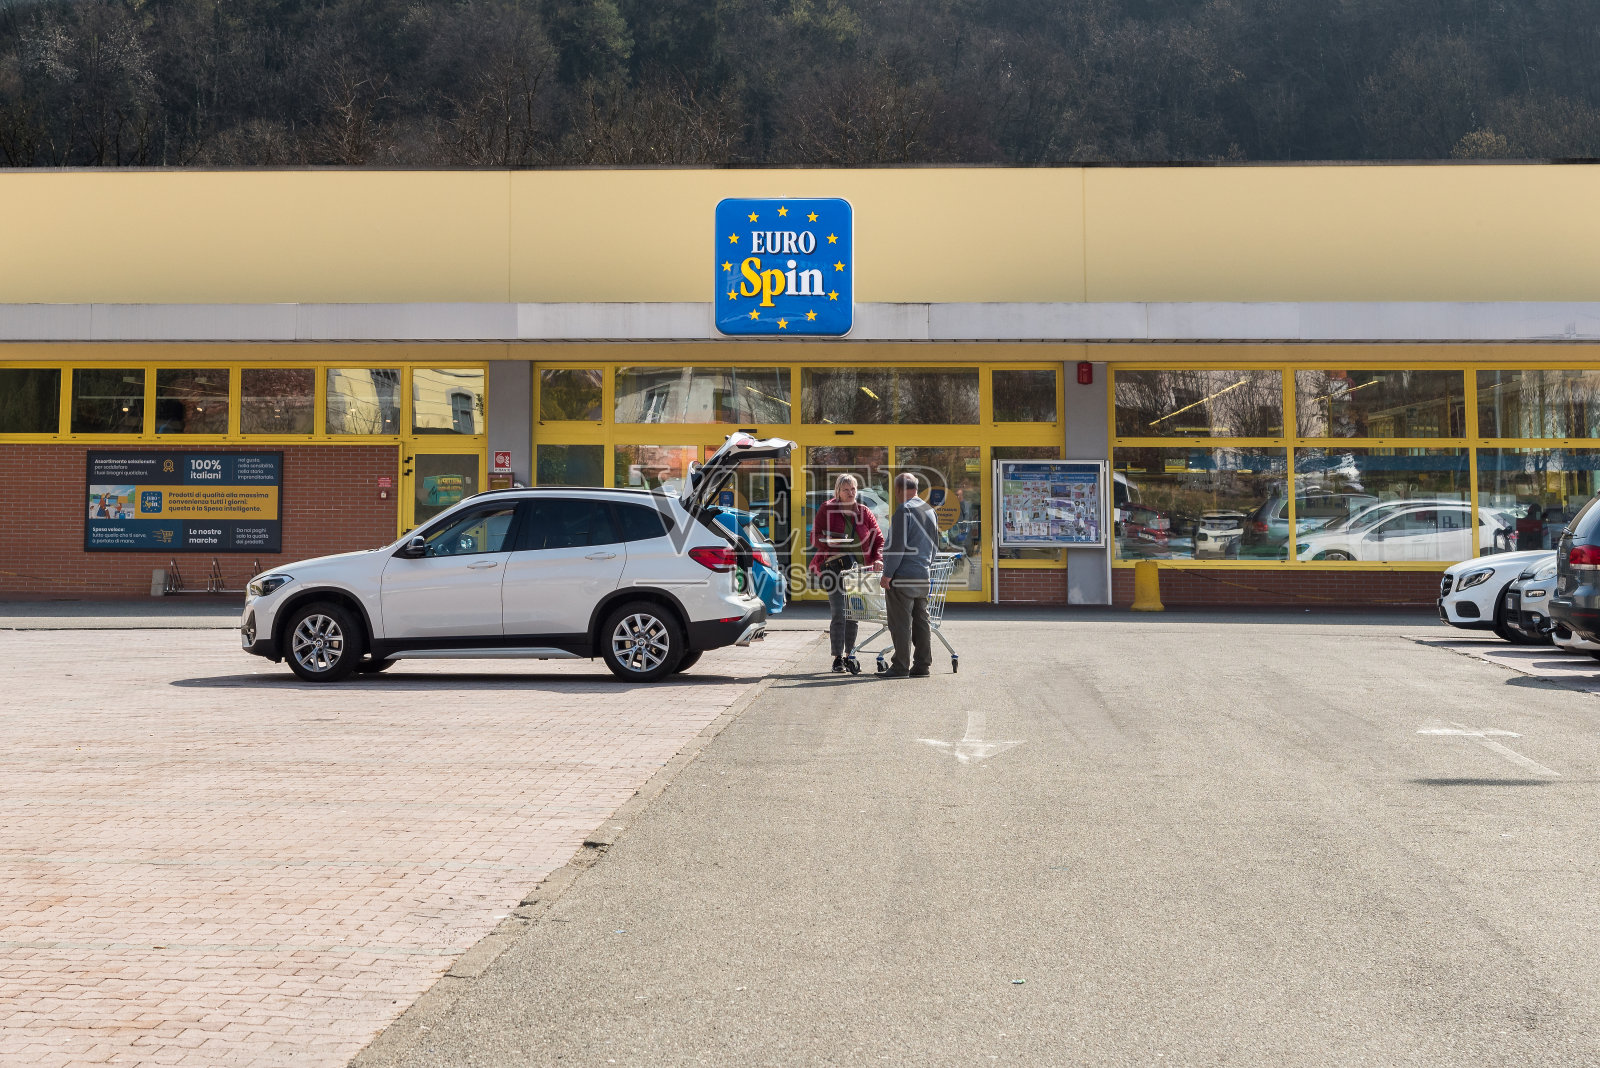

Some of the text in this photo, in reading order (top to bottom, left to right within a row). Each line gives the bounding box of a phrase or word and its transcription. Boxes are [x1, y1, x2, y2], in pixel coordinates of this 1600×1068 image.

[751, 231, 817, 254] EURO
[740, 257, 826, 307] Spin
[190, 460, 222, 470] 100%
[190, 470, 222, 479] italiani
[202, 492, 225, 500] qualità
